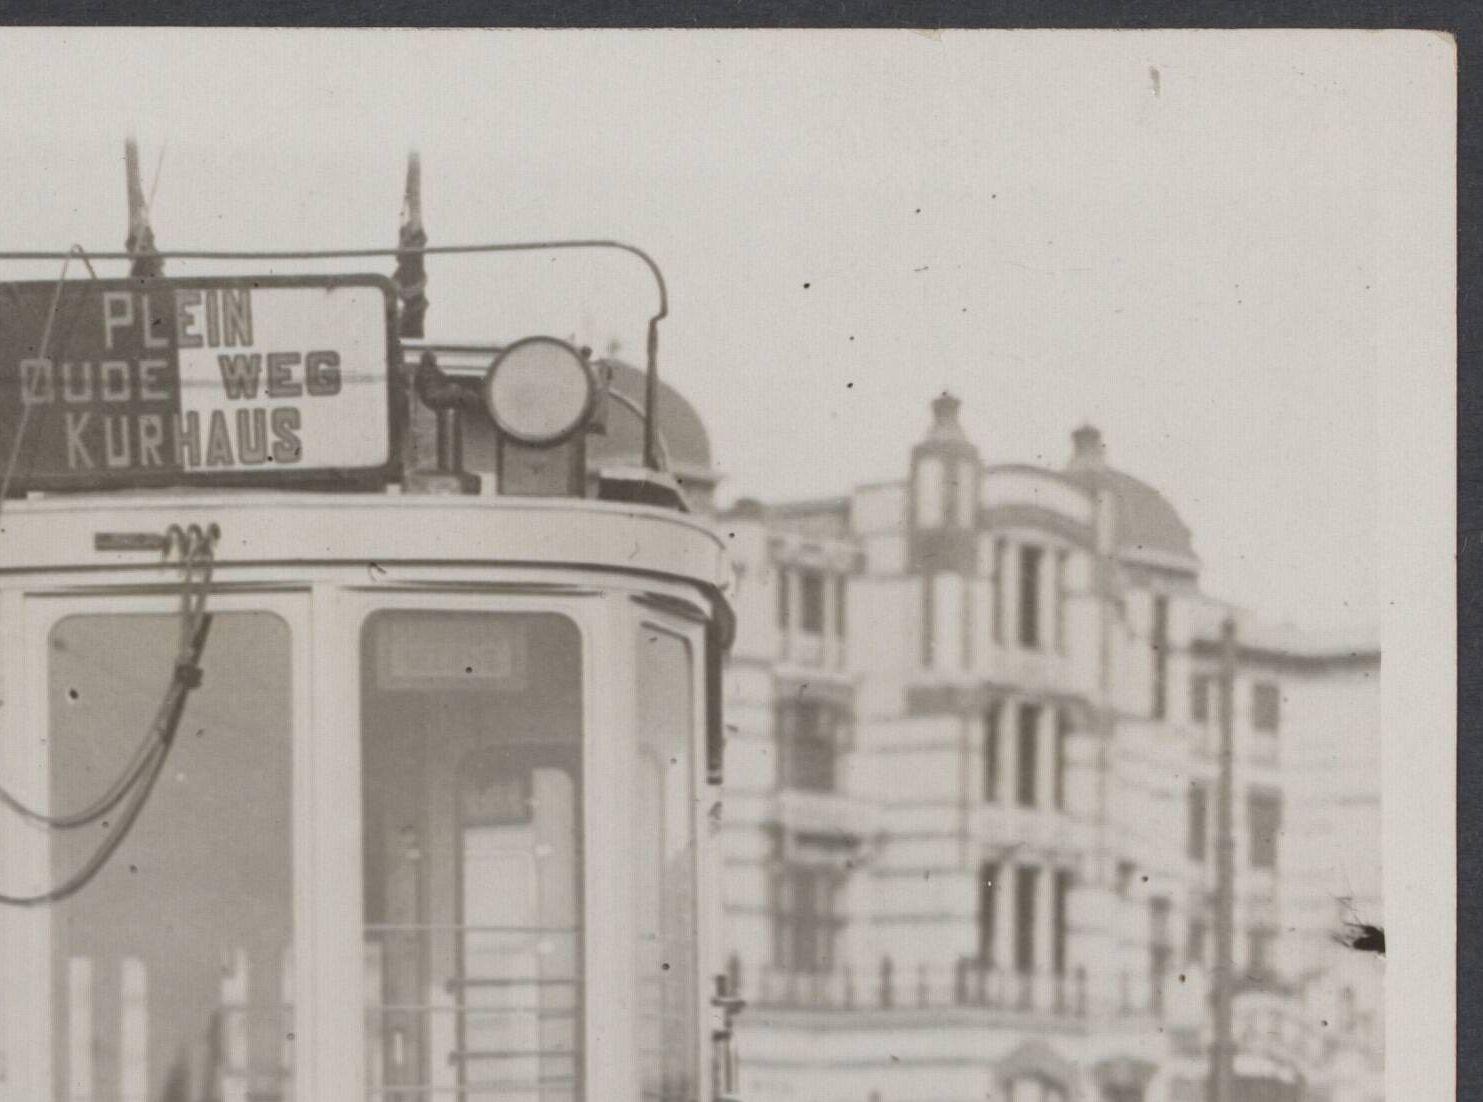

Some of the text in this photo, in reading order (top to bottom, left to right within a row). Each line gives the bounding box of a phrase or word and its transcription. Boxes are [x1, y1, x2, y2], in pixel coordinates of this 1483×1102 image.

[102, 289, 254, 349] PLEIN
[20, 350, 343, 405] OUDE WEG
[65, 407, 303, 469] KURHAUS
